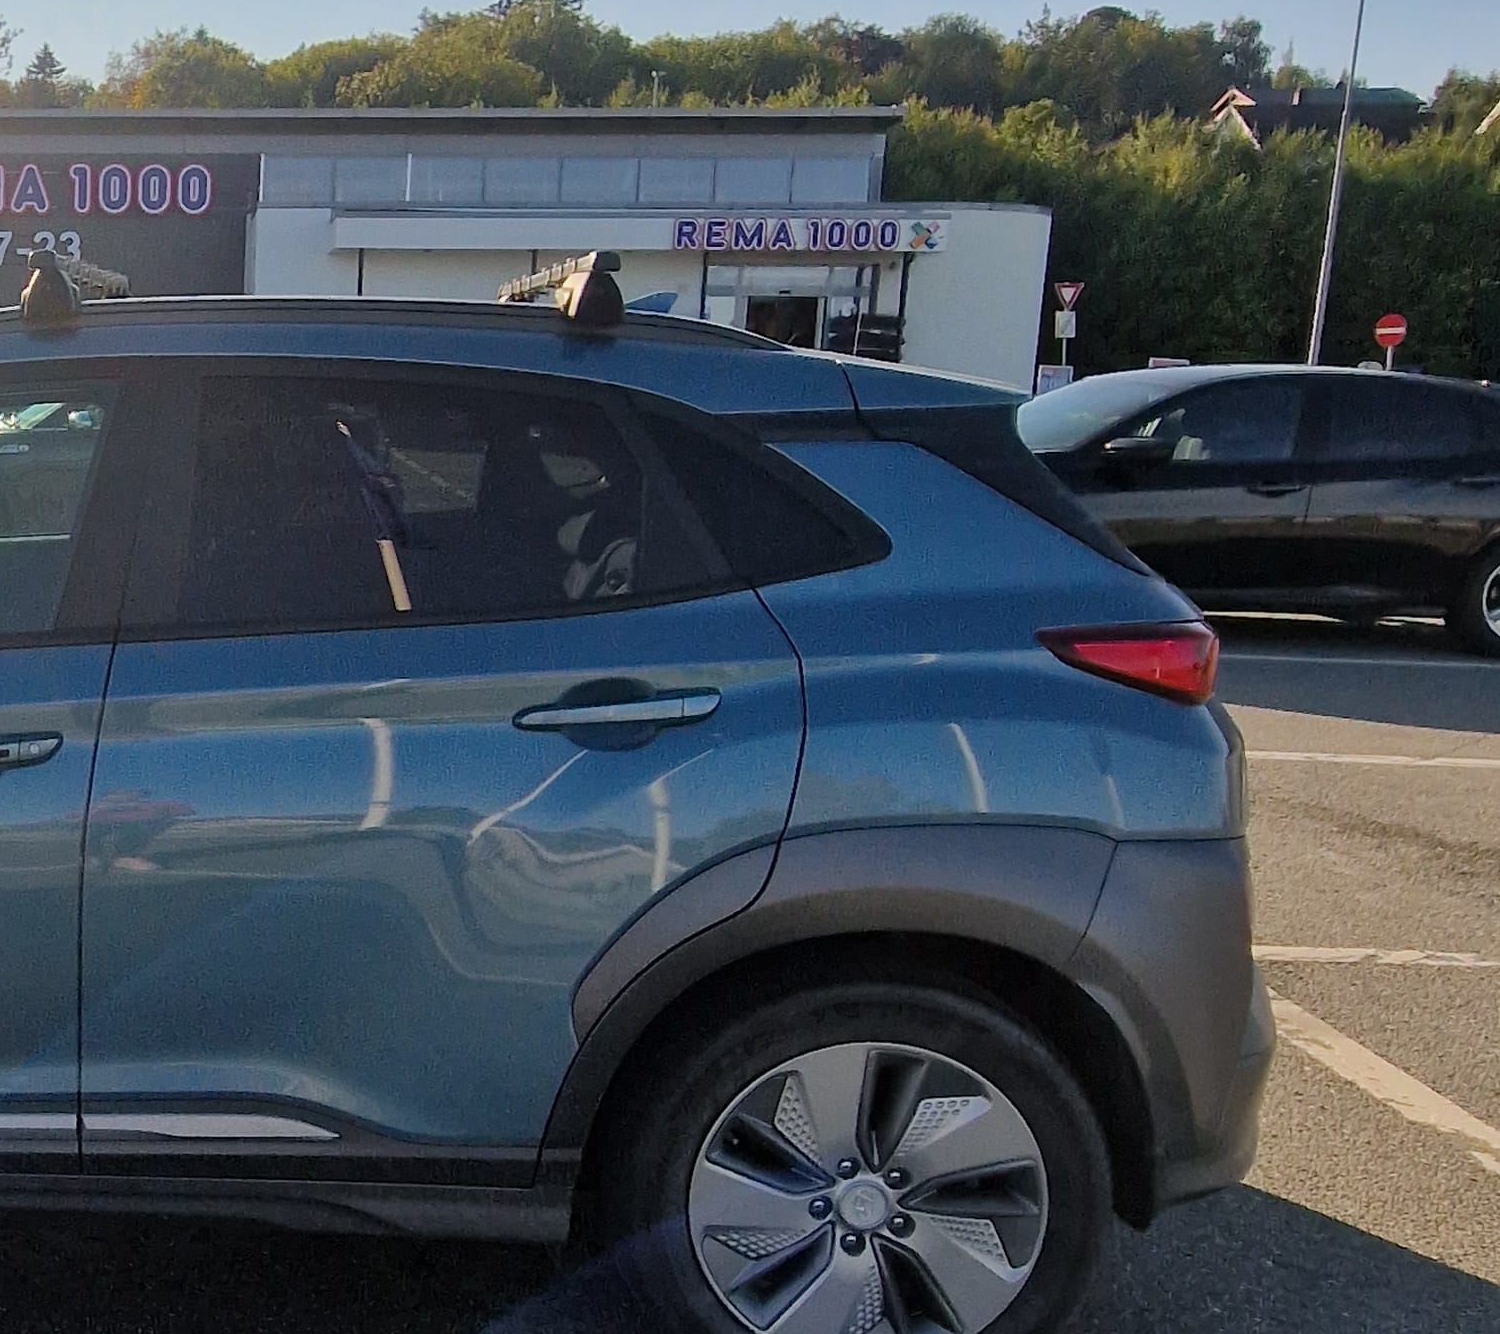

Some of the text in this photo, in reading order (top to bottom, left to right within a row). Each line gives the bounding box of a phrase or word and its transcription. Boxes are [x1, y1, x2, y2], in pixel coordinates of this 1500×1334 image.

[71, 163, 212, 214] 1000
[675, 218, 899, 250] REMA 1000
